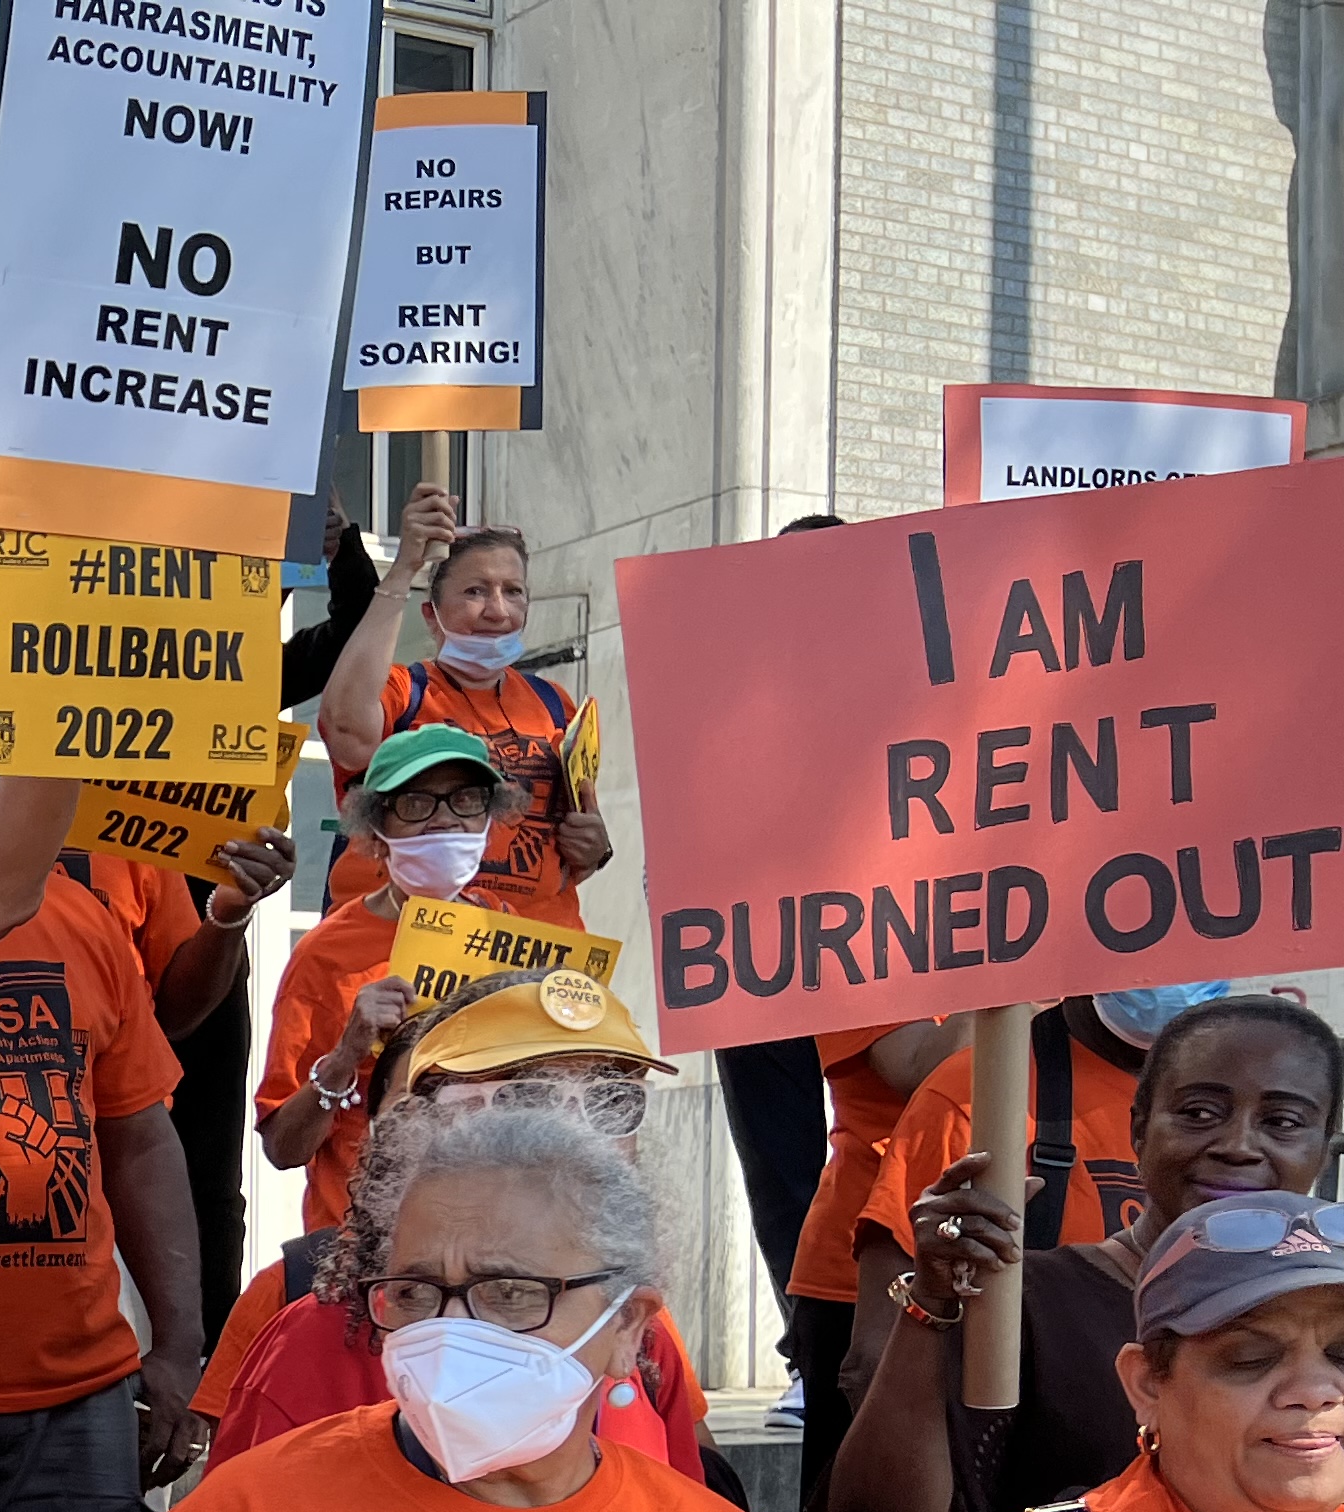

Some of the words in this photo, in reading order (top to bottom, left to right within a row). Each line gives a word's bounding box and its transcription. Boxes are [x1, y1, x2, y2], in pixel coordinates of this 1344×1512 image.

[54, 0, 316, 69] HARRASMENT,
[47, 36, 338, 107] ACCOUNTABILITY
[124, 98, 254, 155] NOW!
[415, 158, 457, 179] NO
[384, 189, 503, 212] REPAIRS
[115, 222, 232, 298] NO
[415, 246, 472, 266] BUT
[96, 304, 229, 358] RENT
[398, 304, 487, 329] RENT
[359, 341, 521, 367] SOARING!
[23, 357, 273, 427] INCREASE
[70, 544, 217, 600] #RENT
[909, 532, 955, 687] I
[989, 560, 1146, 679] AM
[11, 622, 245, 682] ROLLBACK
[55, 705, 175, 760] 2022
[212, 724, 268, 751] RJC
[888, 702, 1218, 842] RENT
[97, 809, 190, 858] 2022
[414, 907, 456, 928] RJC
[661, 864, 1051, 1012] BURNED
[1084, 826, 1343, 954] OUT
[464, 929, 573, 970] #RENT
[547, 986, 602, 1005] POWER
[553, 975, 593, 991] CASA
